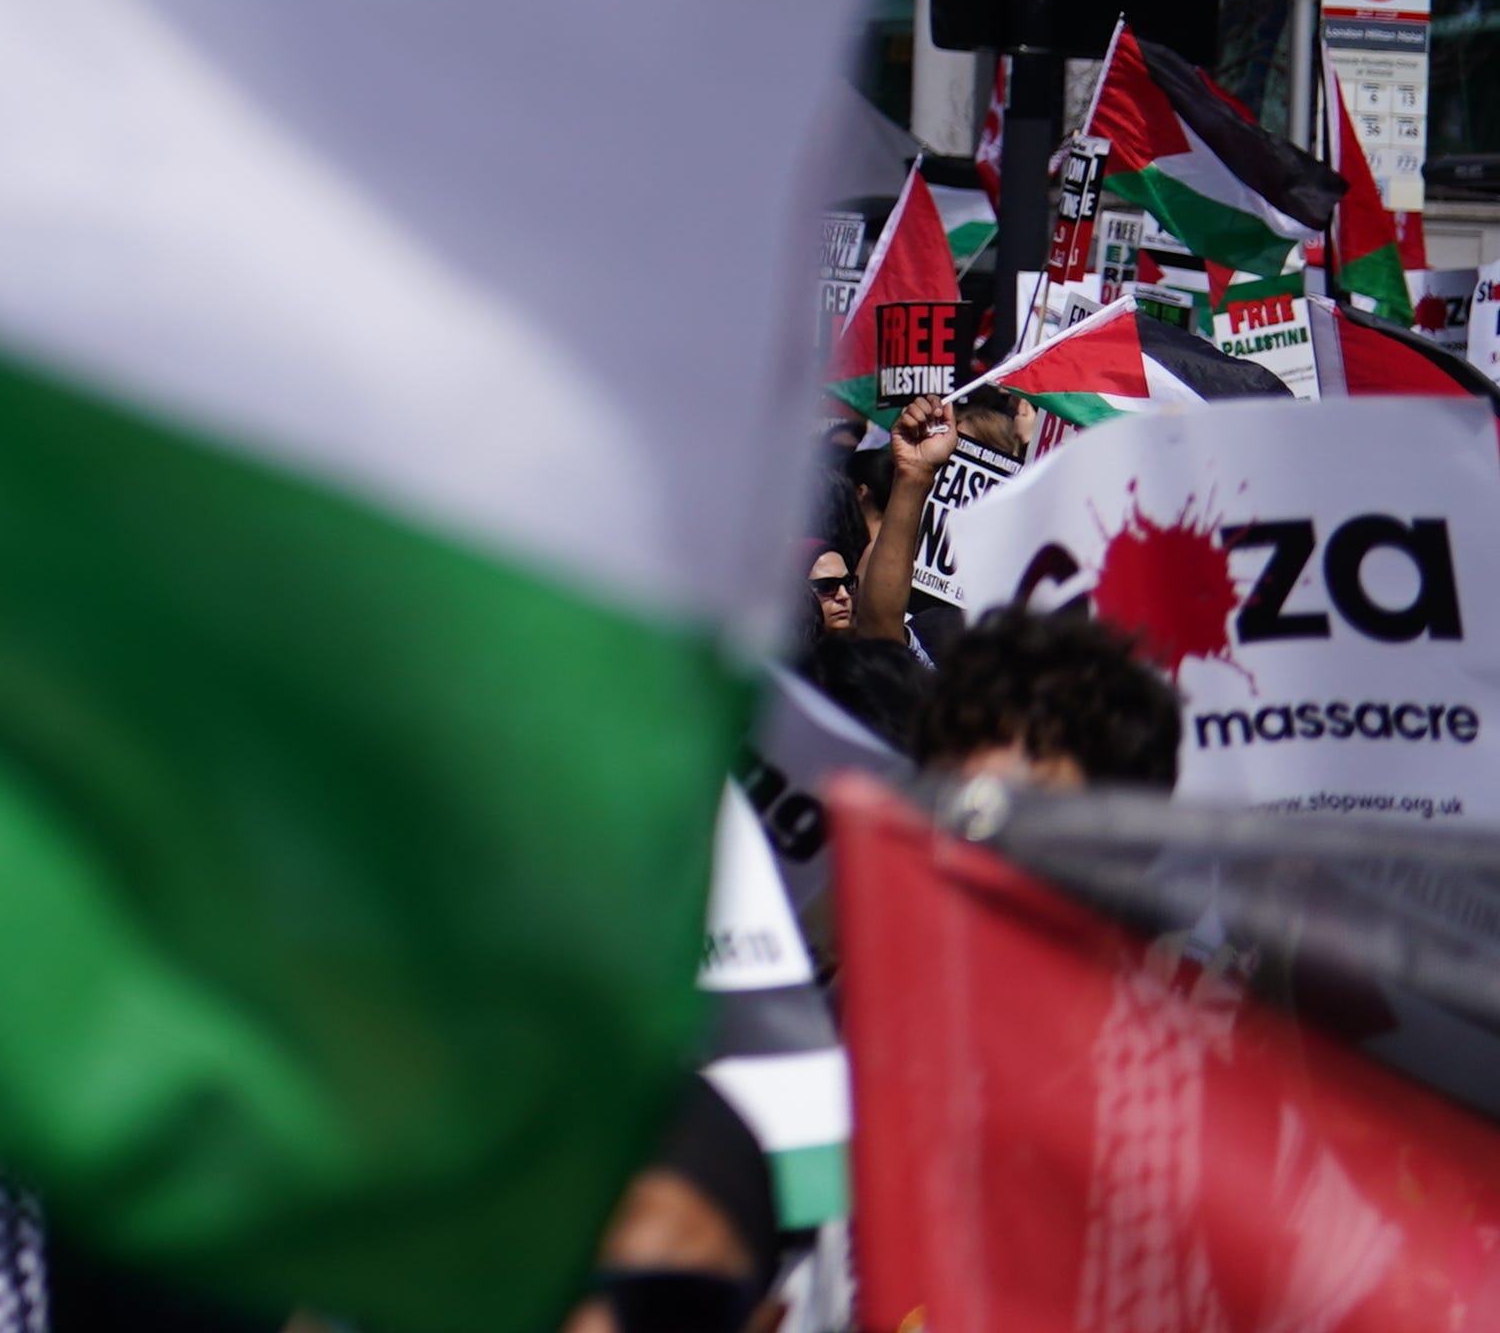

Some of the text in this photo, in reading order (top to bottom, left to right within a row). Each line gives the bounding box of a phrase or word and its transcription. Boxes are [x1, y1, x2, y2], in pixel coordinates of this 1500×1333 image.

[1226, 293, 1296, 336] FREE
[881, 306, 956, 366] FREE
[1221, 326, 1309, 357] PALESTINE
[880, 366, 956, 396] PALESTINE
[911, 570, 950, 594] ALESTINE
[1194, 700, 1480, 748] massacre
